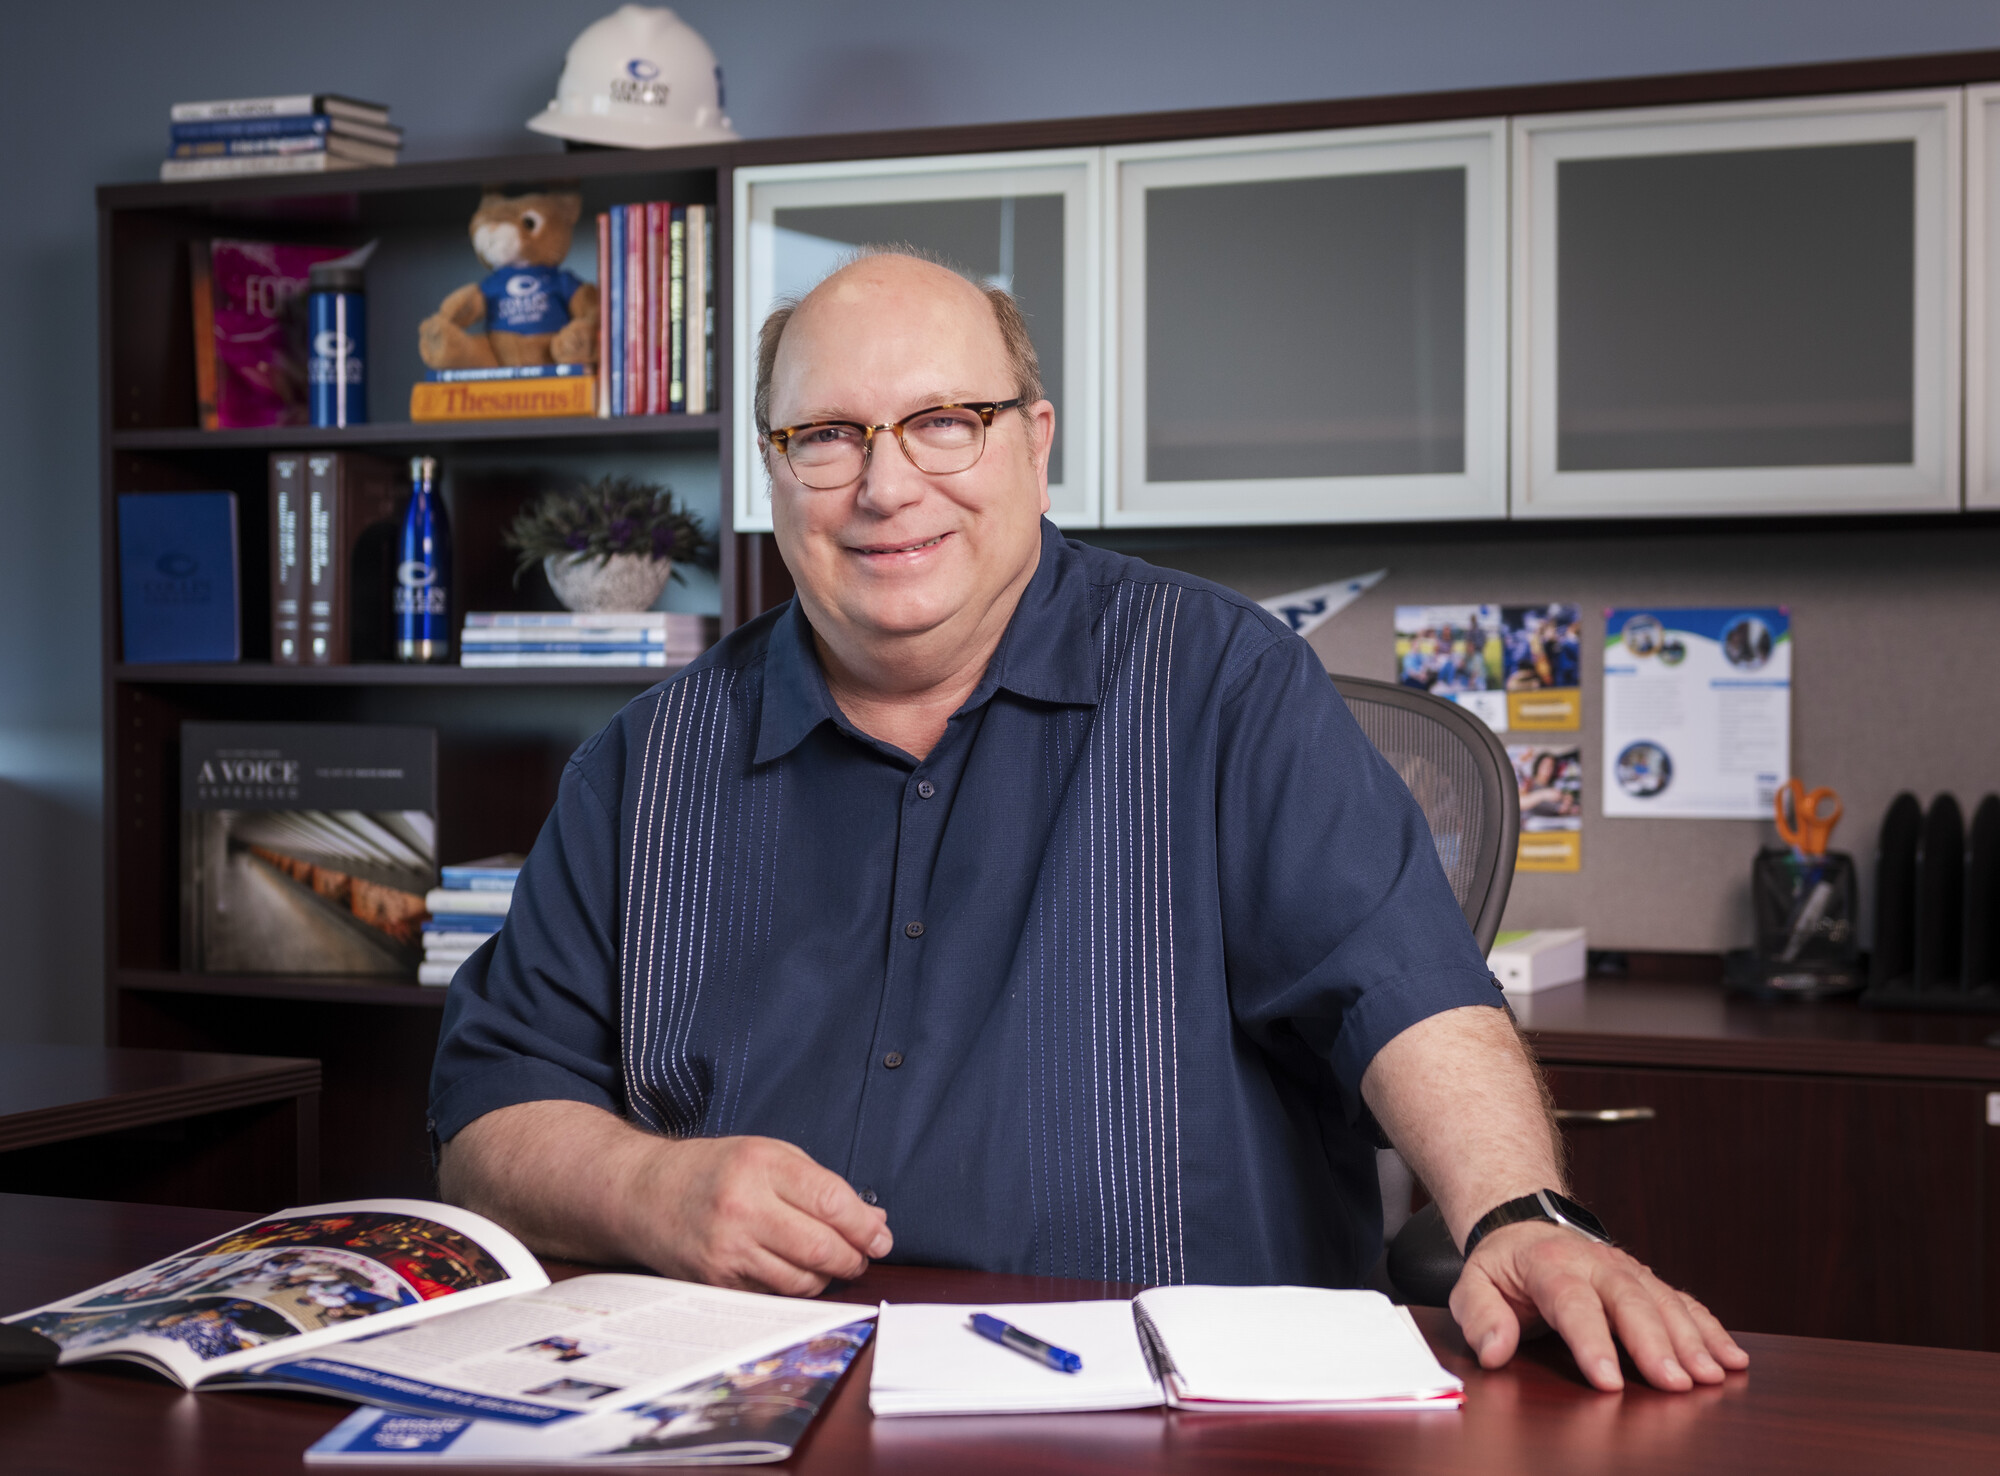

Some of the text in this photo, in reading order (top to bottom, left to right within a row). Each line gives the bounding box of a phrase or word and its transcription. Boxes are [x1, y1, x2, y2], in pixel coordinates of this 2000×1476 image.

[441, 384, 568, 414] Thesaurus
[198, 761, 216, 783] A
[220, 760, 299, 784] VOICE
